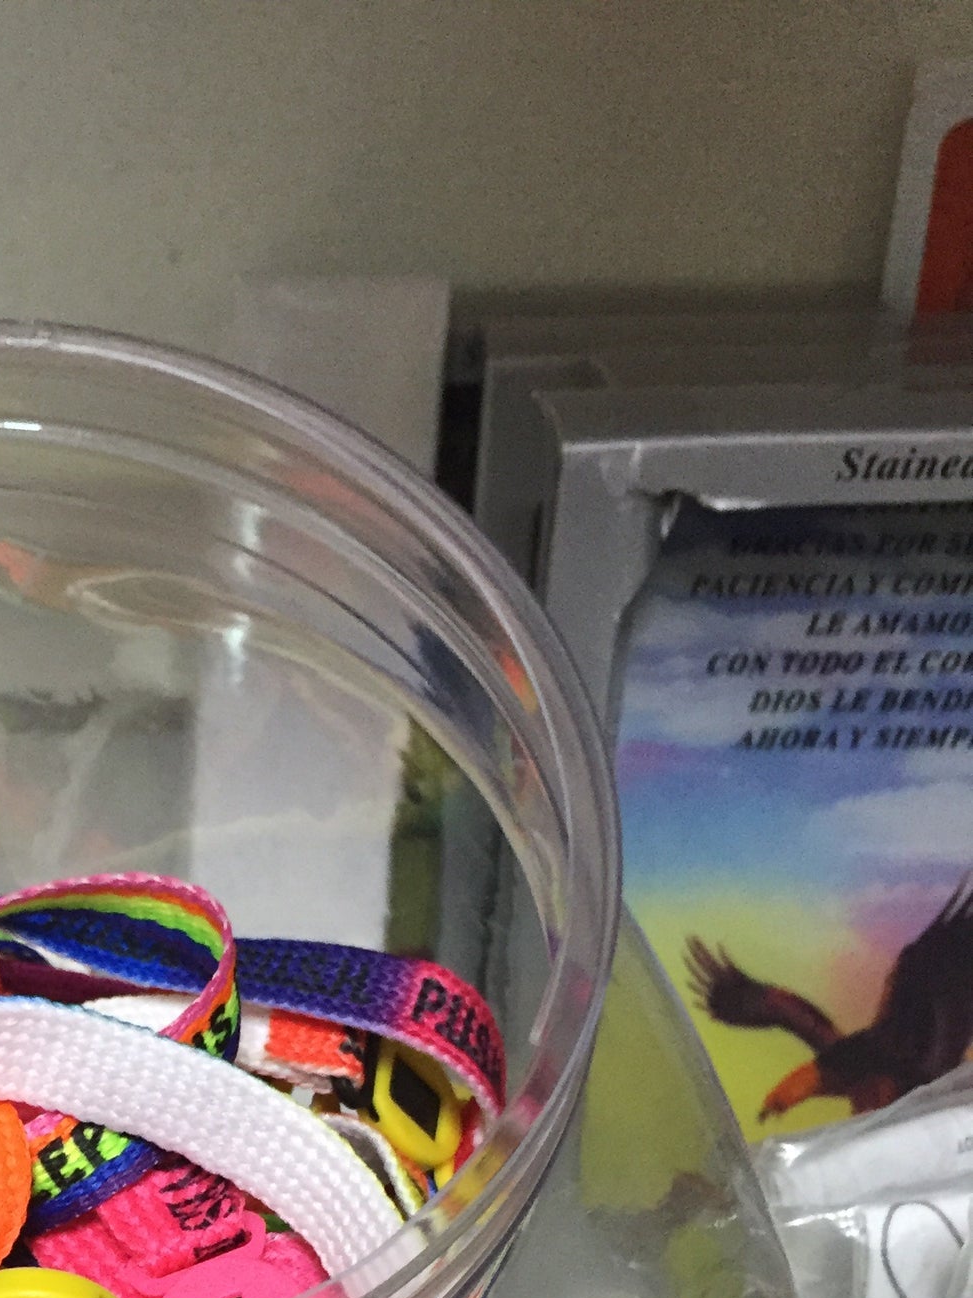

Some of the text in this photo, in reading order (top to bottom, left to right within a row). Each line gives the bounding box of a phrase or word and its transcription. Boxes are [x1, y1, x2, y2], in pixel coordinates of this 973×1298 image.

[689, 572, 855, 597] PACIENCIA
[805, 611, 973, 636] LE AMAMO
[706, 652, 770, 677] CON
[781, 650, 865, 675] TODO
[872, 650, 909, 675] EL
[747, 687, 823, 713] DIOS
[830, 688, 871, 713] LE
[733, 724, 973, 749] AHORA Y SIEMP
